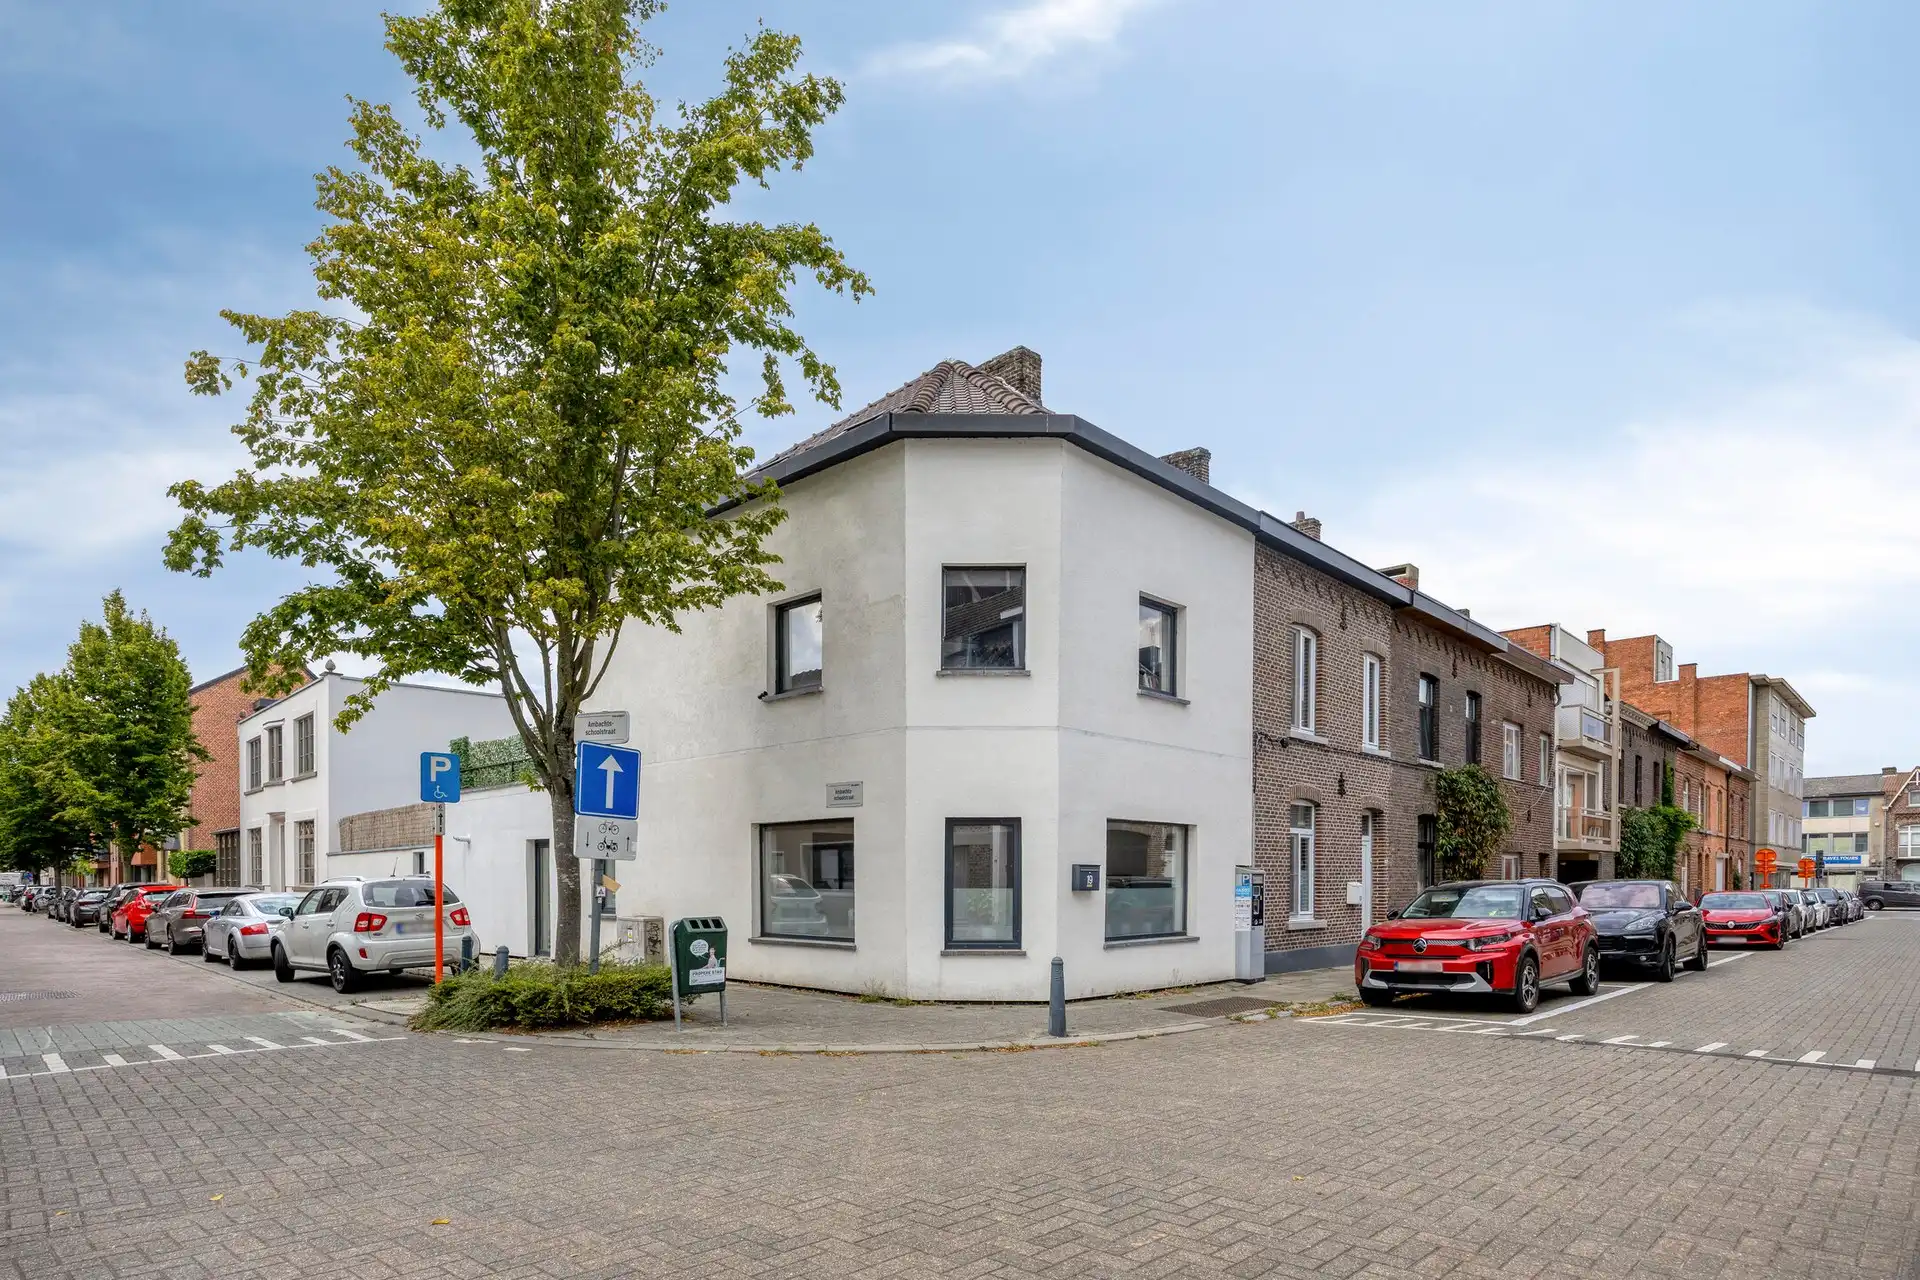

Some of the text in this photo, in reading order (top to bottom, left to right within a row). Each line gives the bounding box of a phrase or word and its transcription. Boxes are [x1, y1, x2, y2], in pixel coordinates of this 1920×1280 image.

[430, 756, 452, 782] P
[1086, 875, 1093, 884] 19
[1243, 874, 1250, 885] P
